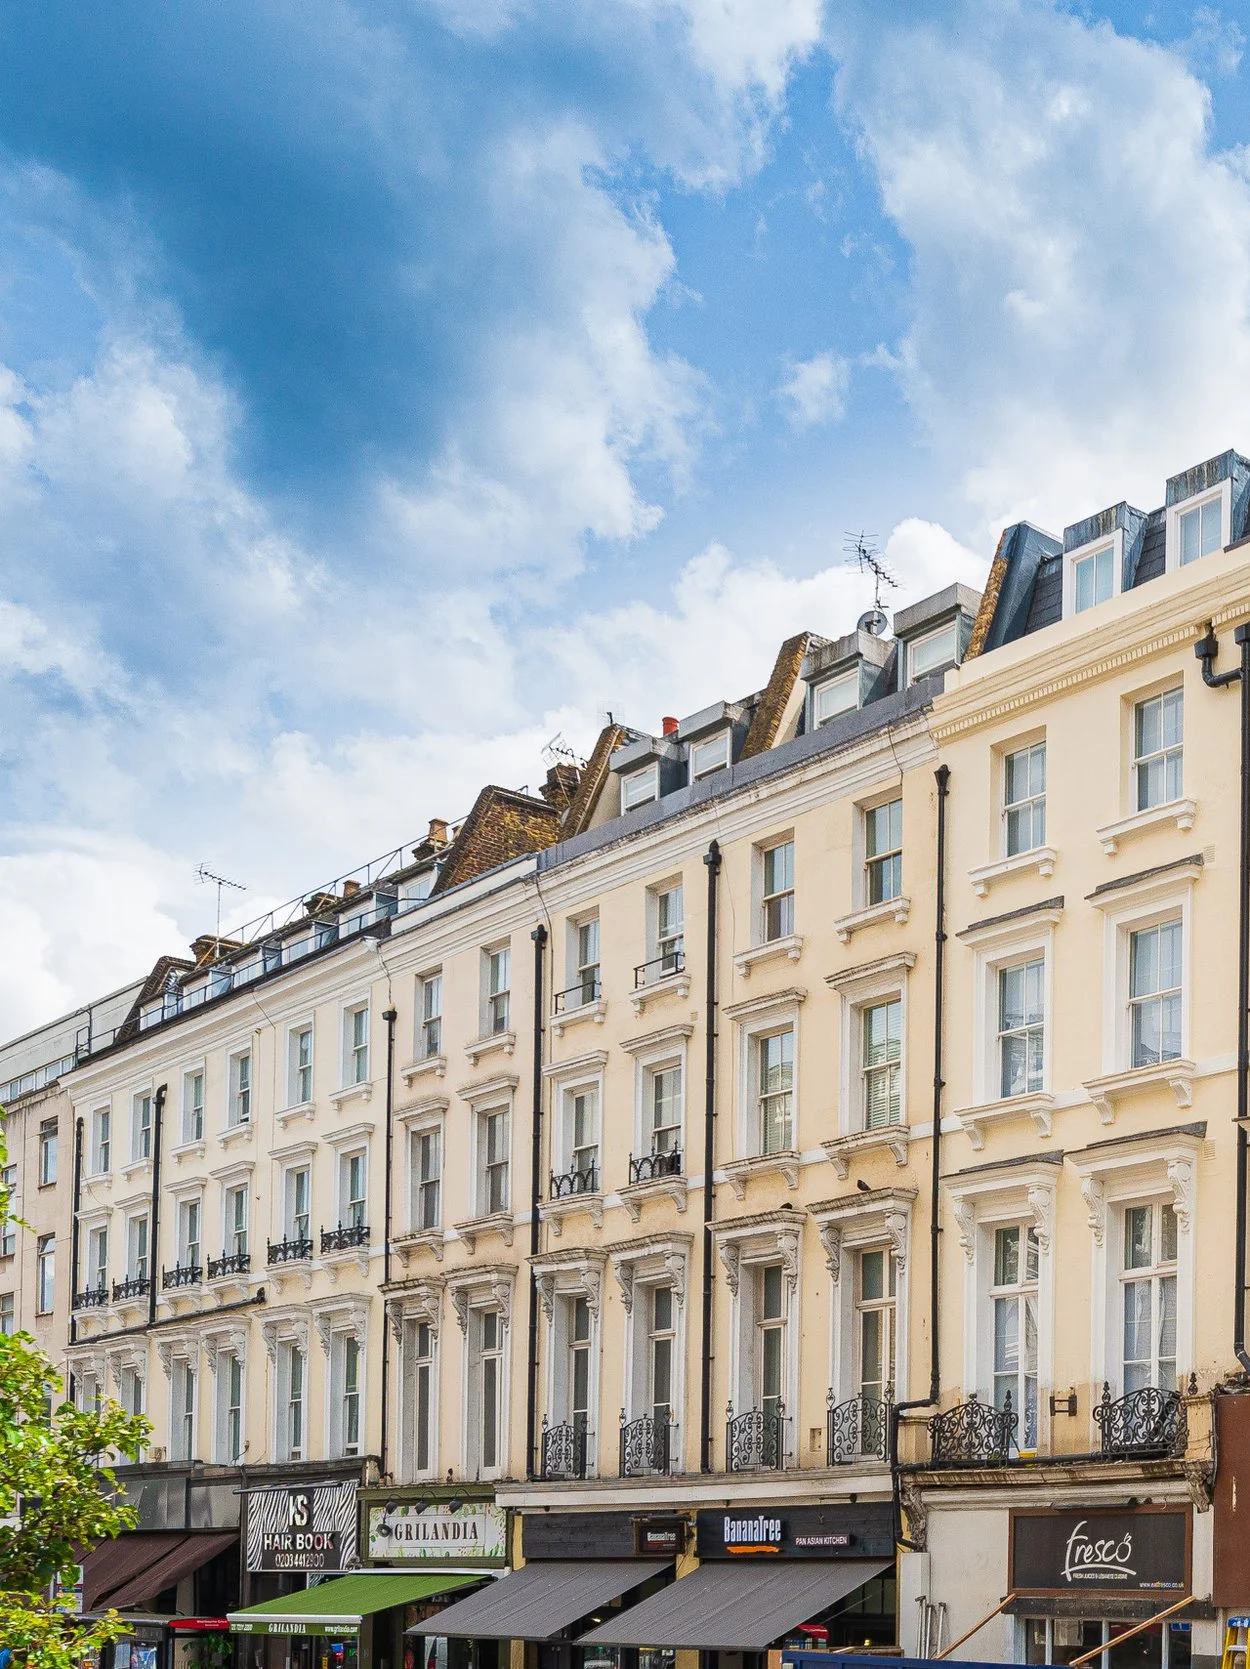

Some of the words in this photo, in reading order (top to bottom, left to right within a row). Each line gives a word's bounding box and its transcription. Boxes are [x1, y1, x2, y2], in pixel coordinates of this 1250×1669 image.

[394, 1521, 479, 1541] GRILANDIA
[724, 1516, 781, 1542] BananaTree
[264, 1533, 294, 1551] HAIR
[296, 1532, 334, 1550] BOOK
[795, 1536, 807, 1546] PAN
[807, 1536, 824, 1545] ASIAN
[824, 1535, 848, 1545] KITCHEN
[268, 1623, 306, 1634] GRILANDIA
